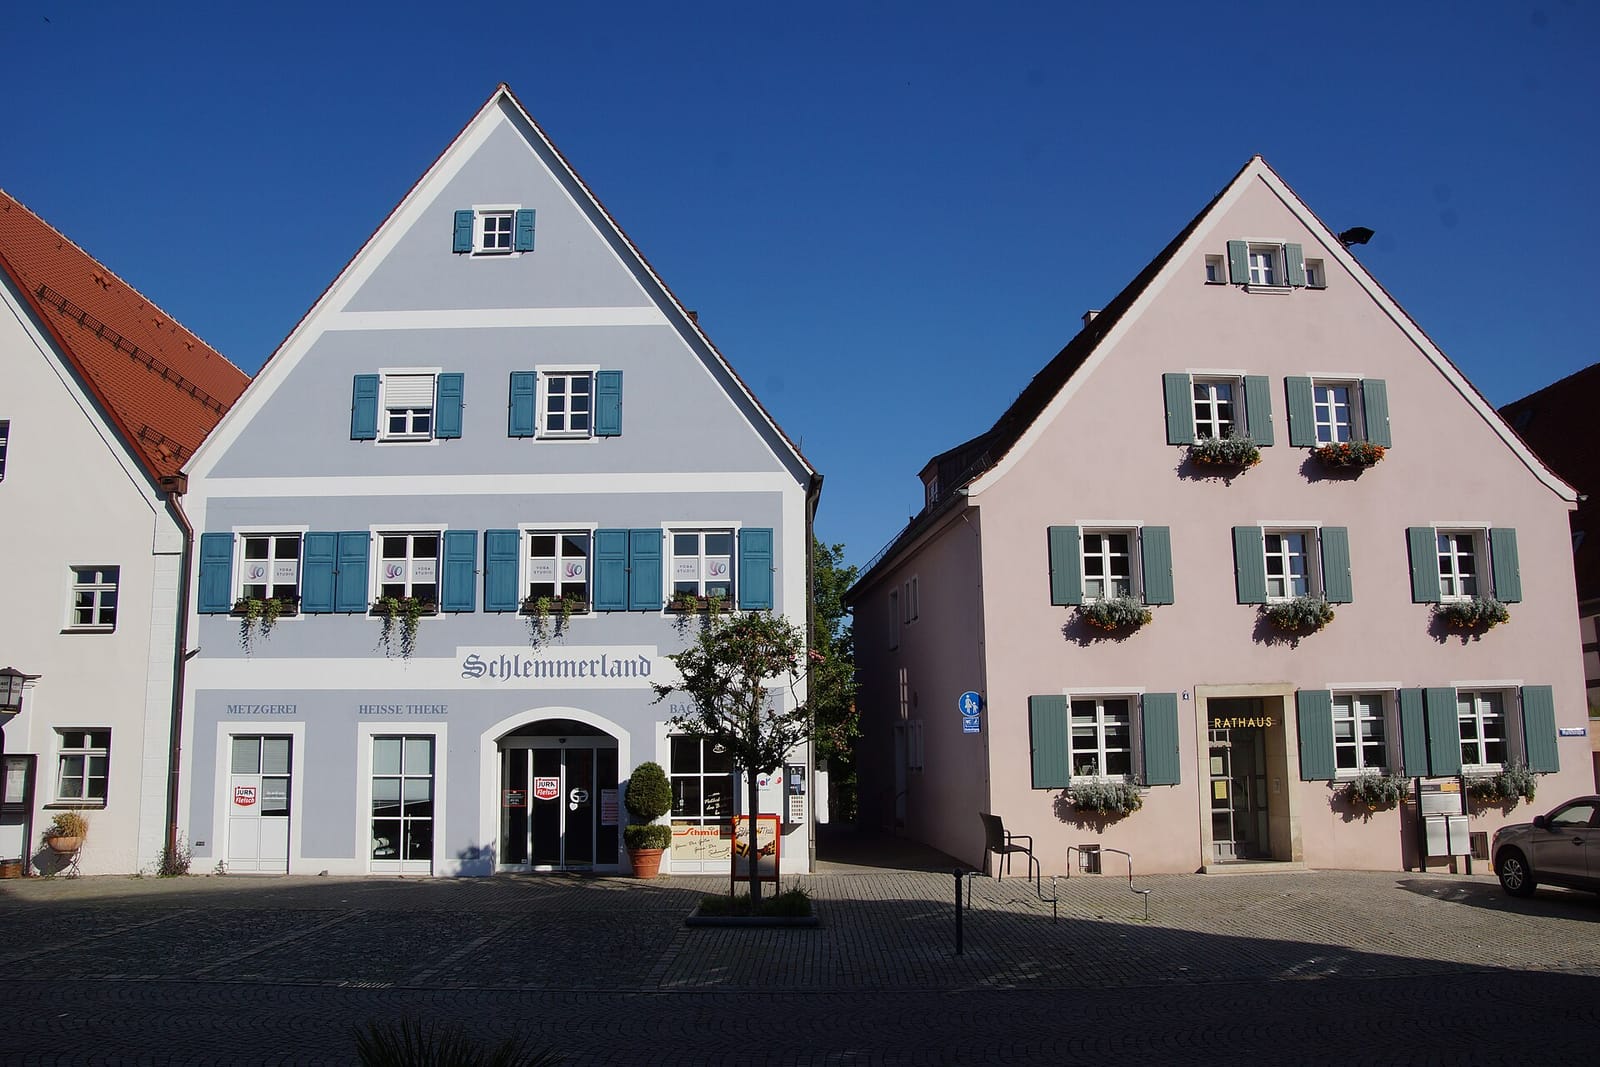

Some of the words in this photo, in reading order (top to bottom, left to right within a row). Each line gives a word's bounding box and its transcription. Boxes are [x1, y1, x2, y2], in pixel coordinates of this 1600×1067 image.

[461, 653, 651, 682] Schlemmerland
[226, 704, 297, 714] METZGEREI
[359, 704, 403, 714] HEISSE
[405, 704, 448, 714] THEKE
[1214, 716, 1272, 728] RATHAUS
[537, 788, 557, 796] Fleisch
